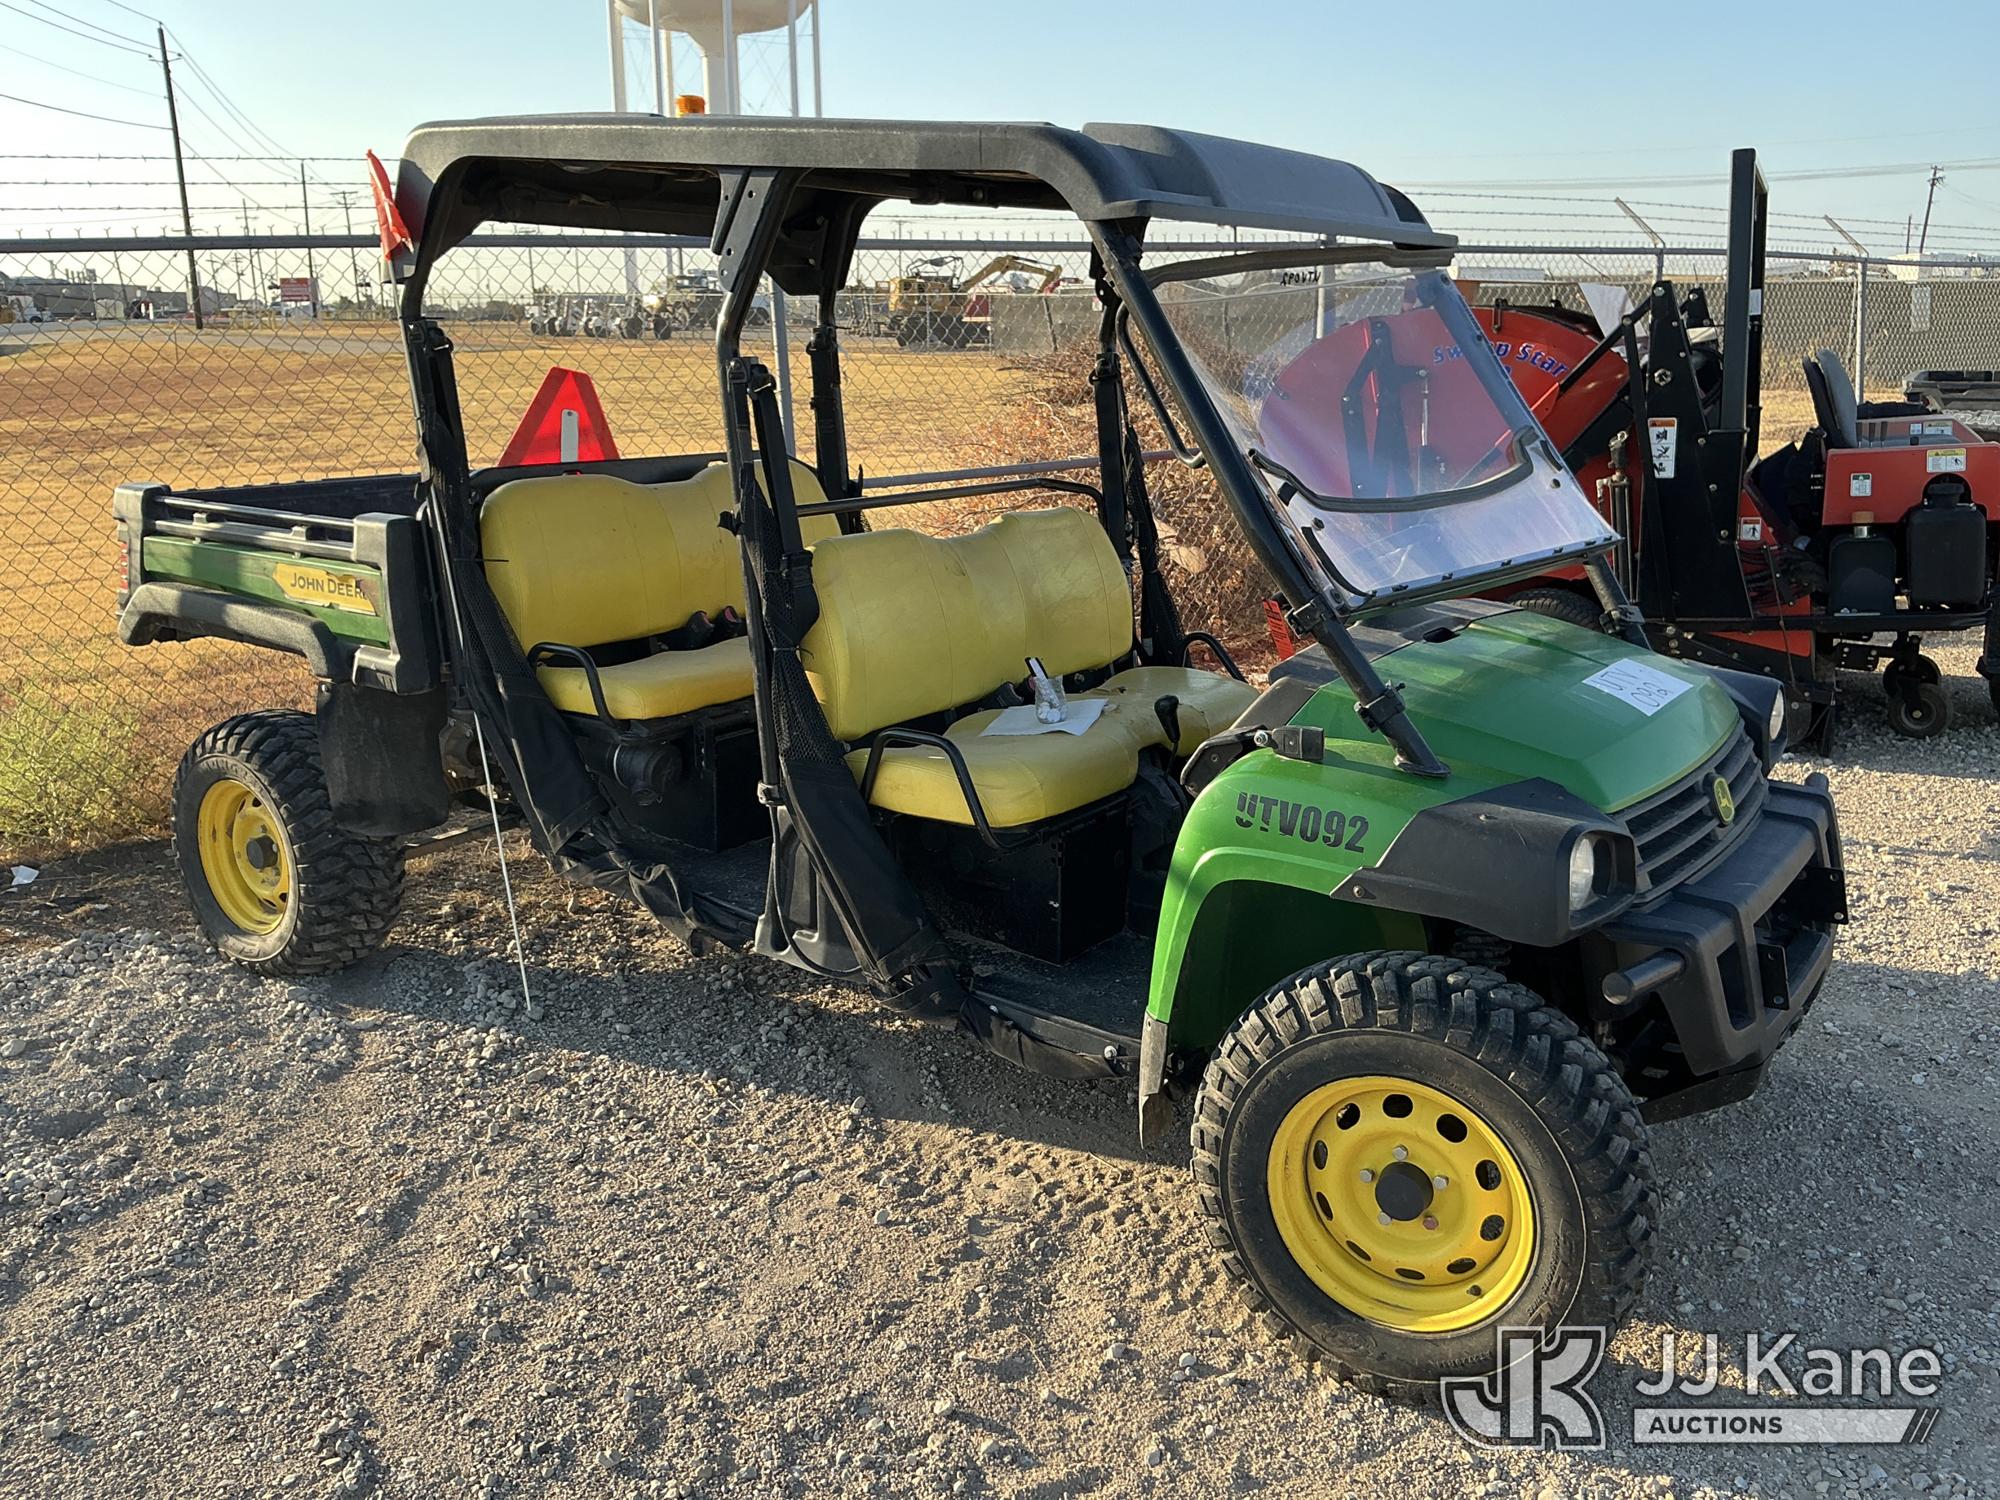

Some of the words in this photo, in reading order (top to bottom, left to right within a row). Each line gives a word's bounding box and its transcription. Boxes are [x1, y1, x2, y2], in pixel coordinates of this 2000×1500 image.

[1516, 342, 1569, 377] Star
[290, 572, 325, 593] JOHN
[327, 578, 367, 600] DEER
[1590, 667, 1639, 692] UTV
[1235, 791, 1369, 854] UTV092
